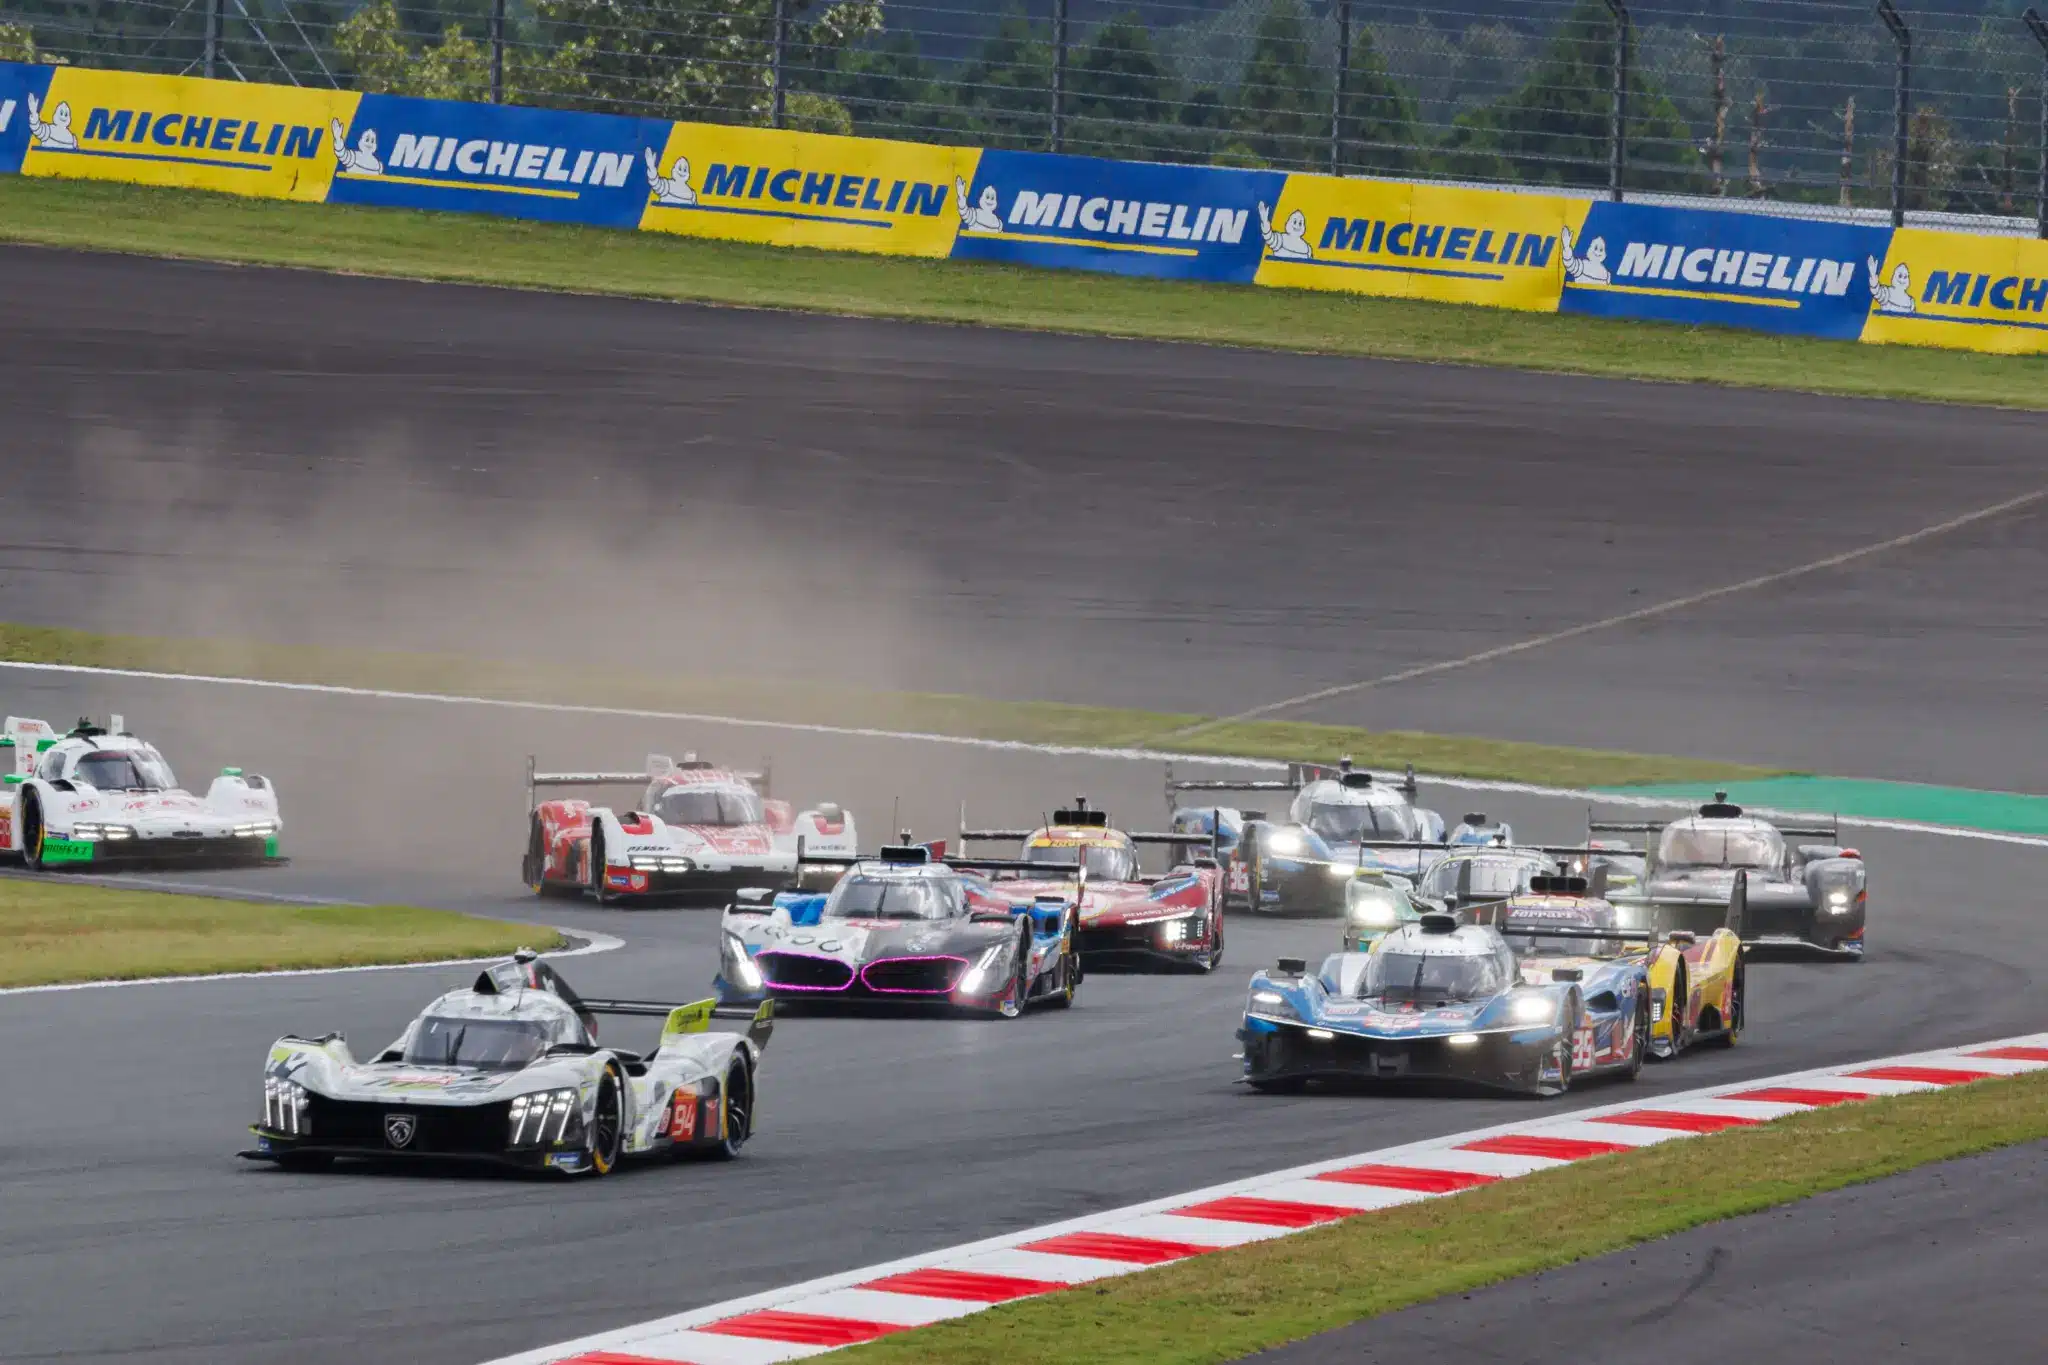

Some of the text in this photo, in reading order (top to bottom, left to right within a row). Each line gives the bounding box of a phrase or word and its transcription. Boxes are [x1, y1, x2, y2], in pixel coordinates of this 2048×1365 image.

[84, 108, 323, 158] MICHELIN
[388, 134, 634, 187] MICHELIN
[702, 164, 948, 217] MICHELIN
[1008, 190, 1249, 243] MICHELIN
[1320, 218, 1555, 267] MICHELIN
[1616, 242, 1855, 296] MICHELIN
[1922, 271, 2048, 311] MICH
[671, 1103, 695, 1136] 94
